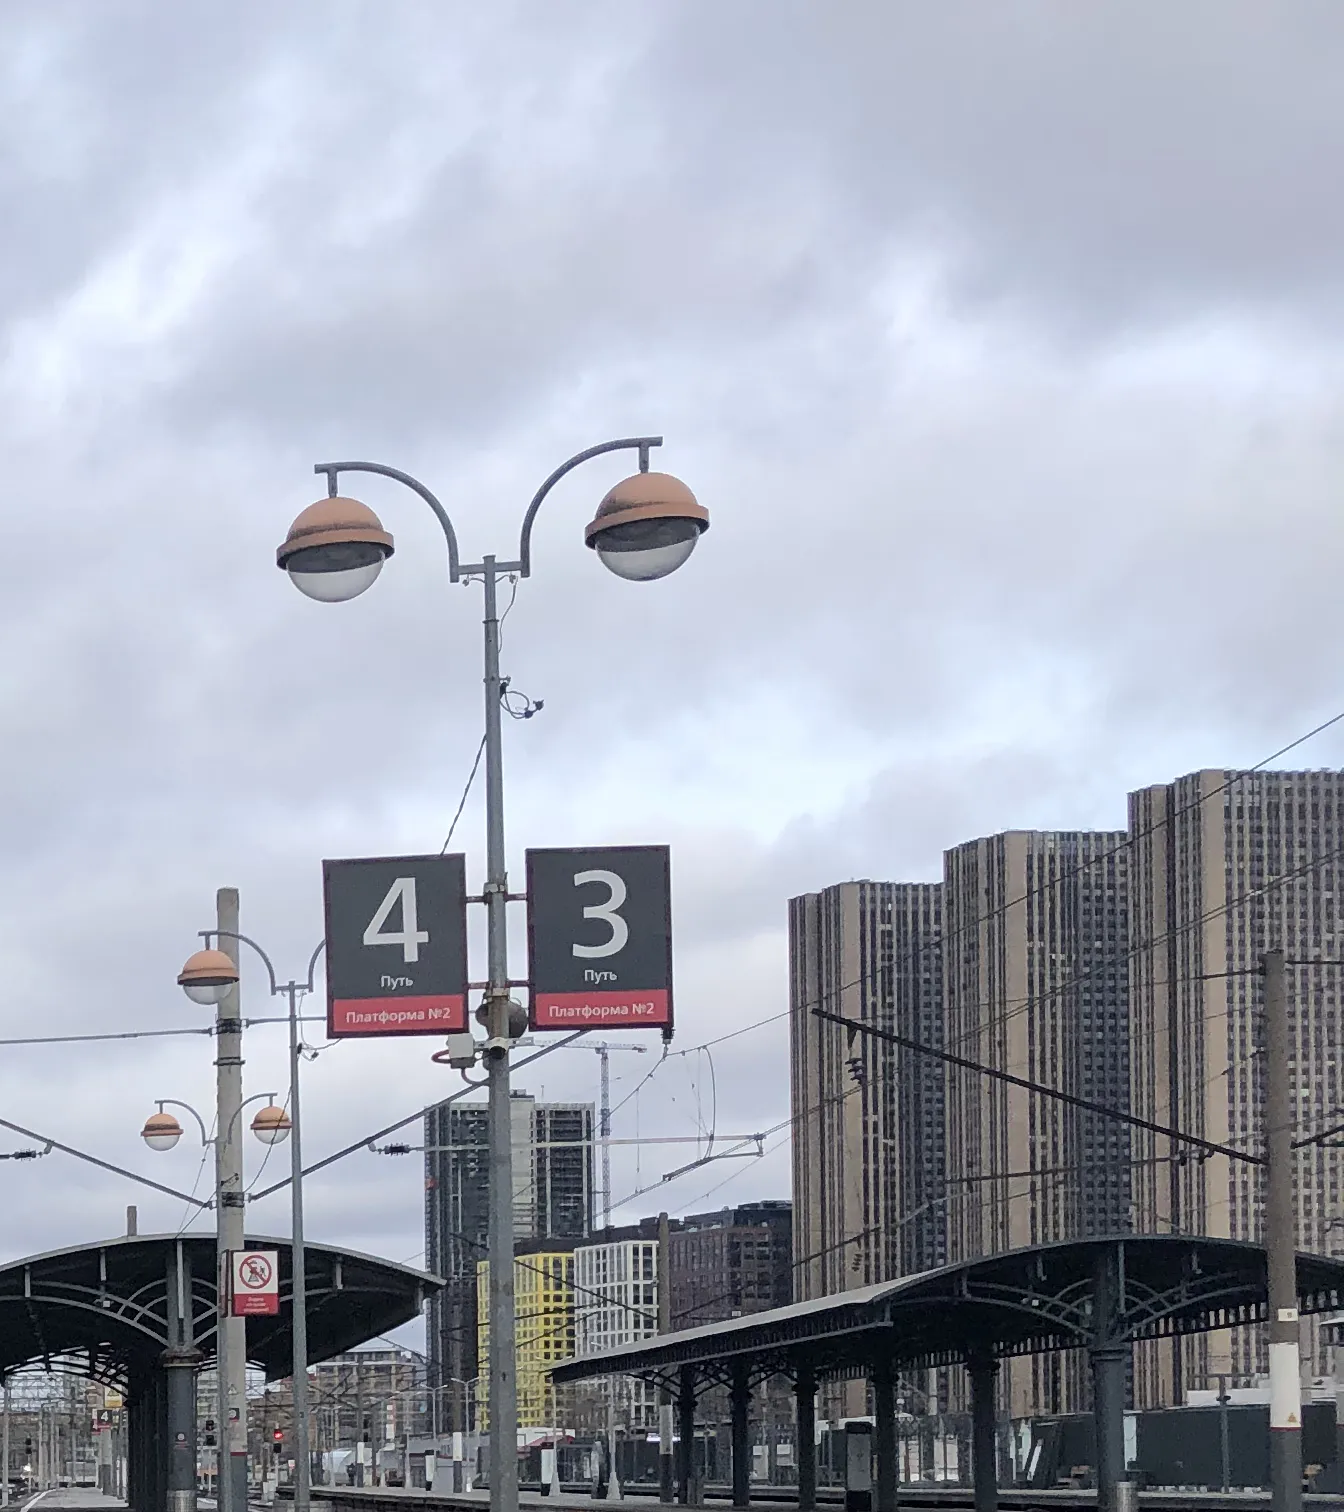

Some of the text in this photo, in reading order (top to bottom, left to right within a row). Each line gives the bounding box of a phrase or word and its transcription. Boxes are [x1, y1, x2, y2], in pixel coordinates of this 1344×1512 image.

[363, 877, 429, 962] 4
[572, 869, 629, 958] 3
[380, 975, 414, 991] Путь
[584, 969, 618, 985] Путь
[345, 1007, 451, 1025] Платформа №2
[548, 1002, 655, 1019] Платформа №2
[100, 1410, 109, 1422] 4
